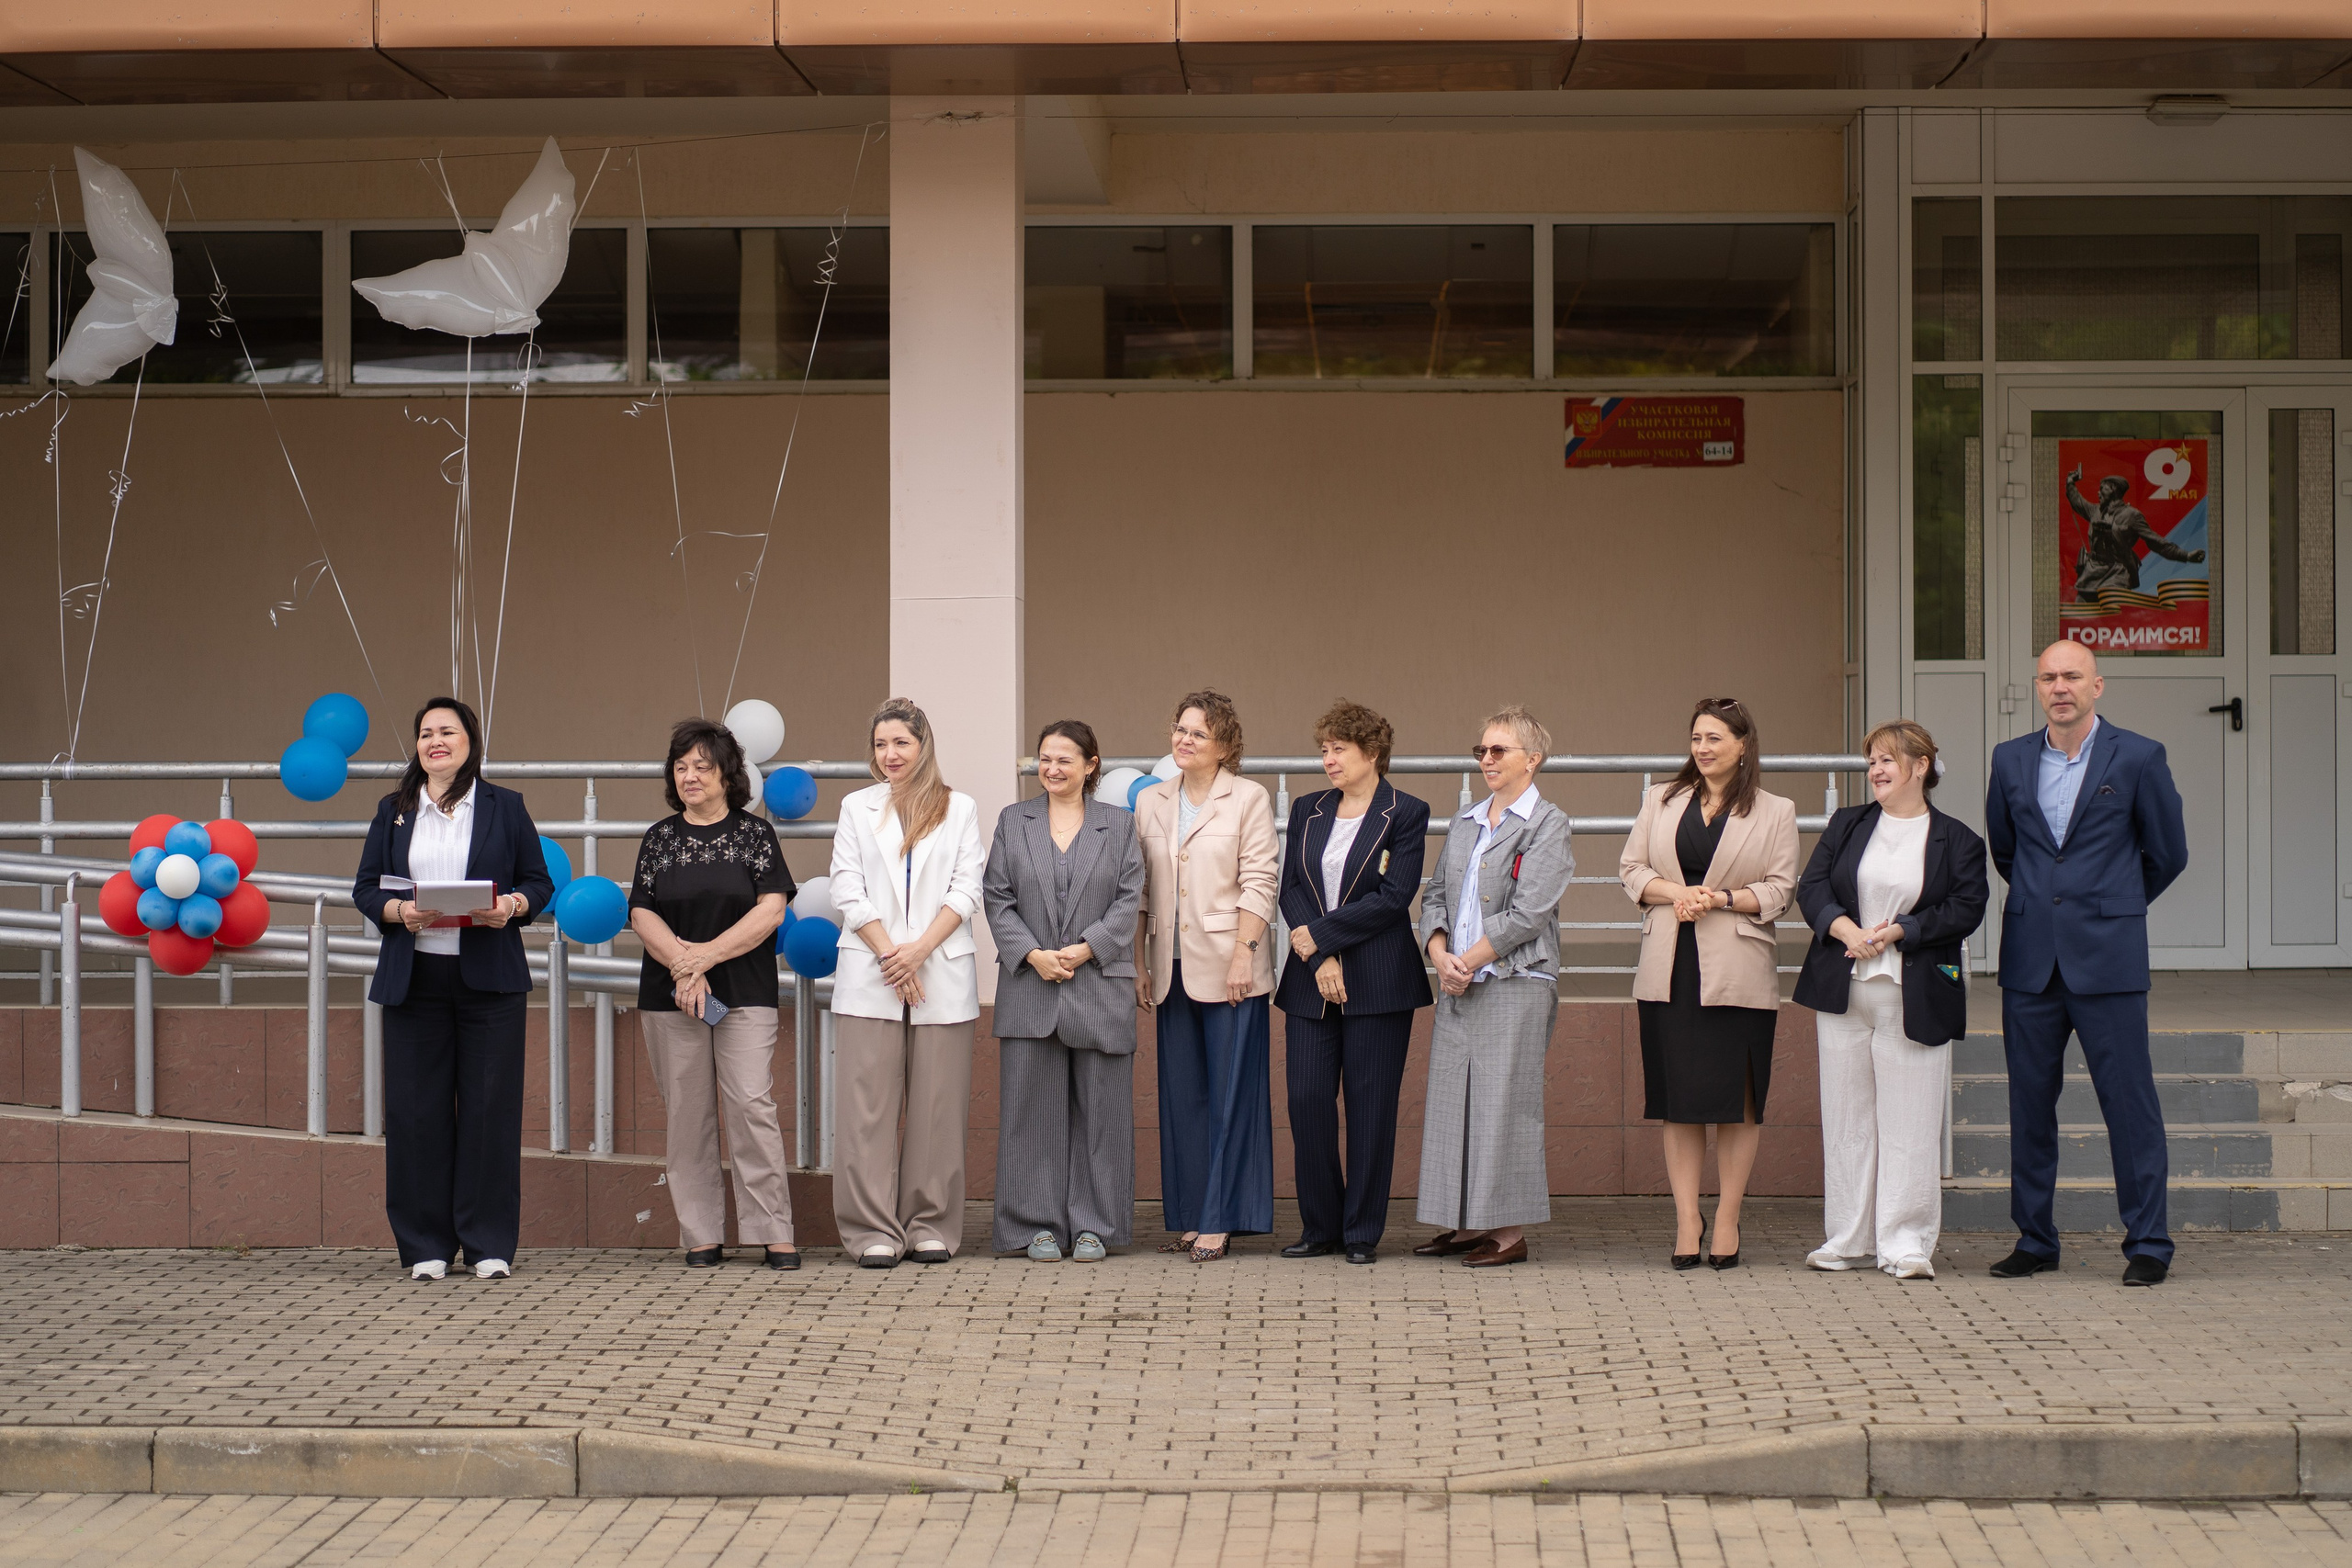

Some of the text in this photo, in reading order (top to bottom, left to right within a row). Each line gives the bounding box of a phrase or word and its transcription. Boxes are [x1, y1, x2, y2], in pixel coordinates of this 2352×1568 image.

[1630, 404, 1719, 416] УЧАСТКОВАЯ
[1617, 417, 1732, 428] ИЗБИРАТЕЛЬНАЯ
[1637, 429, 1713, 440] КОМИССИЯ
[1575, 448, 1650, 459] ИЗБИРАТЕЛЬНОГО
[1653, 448, 1690, 459] УЧАСТКА
[1704, 446, 1733, 456] 64-14
[2143, 447, 2191, 500] 9
[2168, 489, 2198, 500] МАЯ
[2067, 626, 2201, 647] ГОРДИМСЯ!
